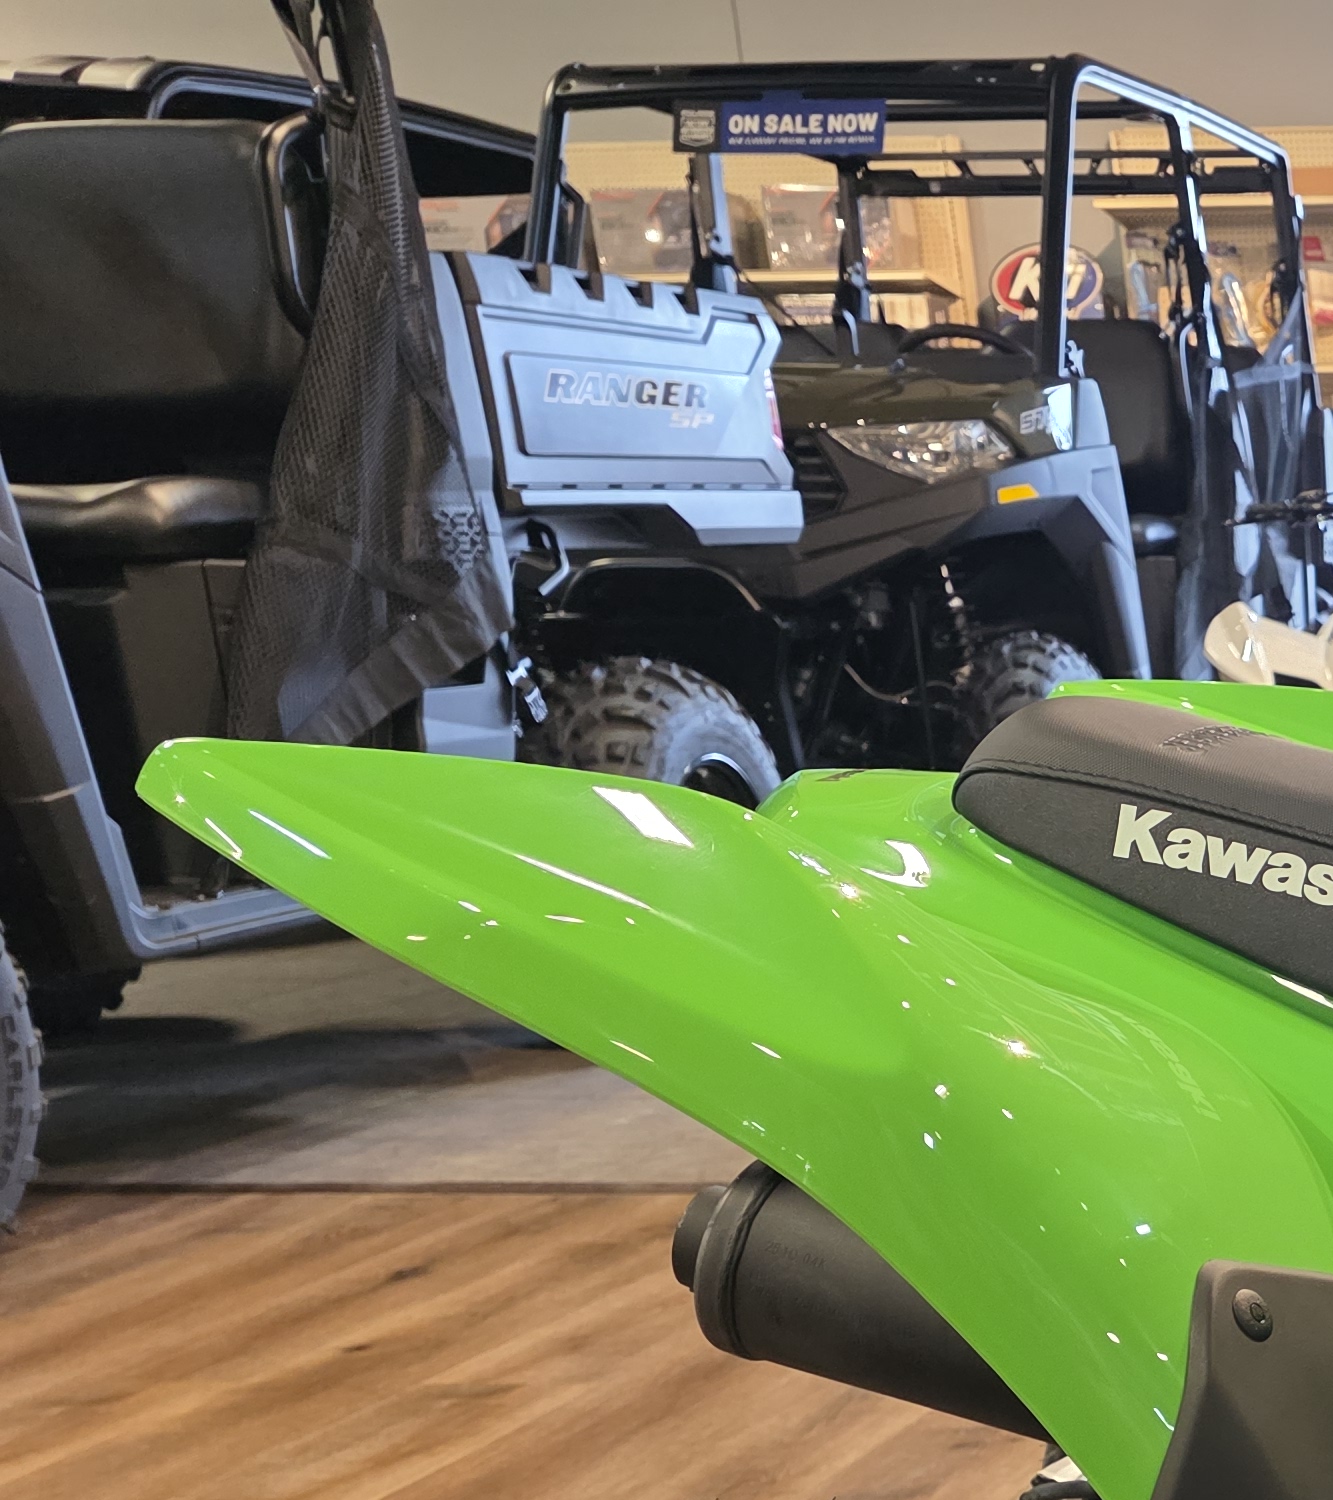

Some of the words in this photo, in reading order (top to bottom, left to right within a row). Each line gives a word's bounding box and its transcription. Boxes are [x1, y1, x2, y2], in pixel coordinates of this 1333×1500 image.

[728, 114, 760, 134] ON
[764, 113, 824, 134] SALE
[827, 112, 879, 133] NOW
[544, 368, 710, 409] RANGER
[669, 411, 715, 429] SP
